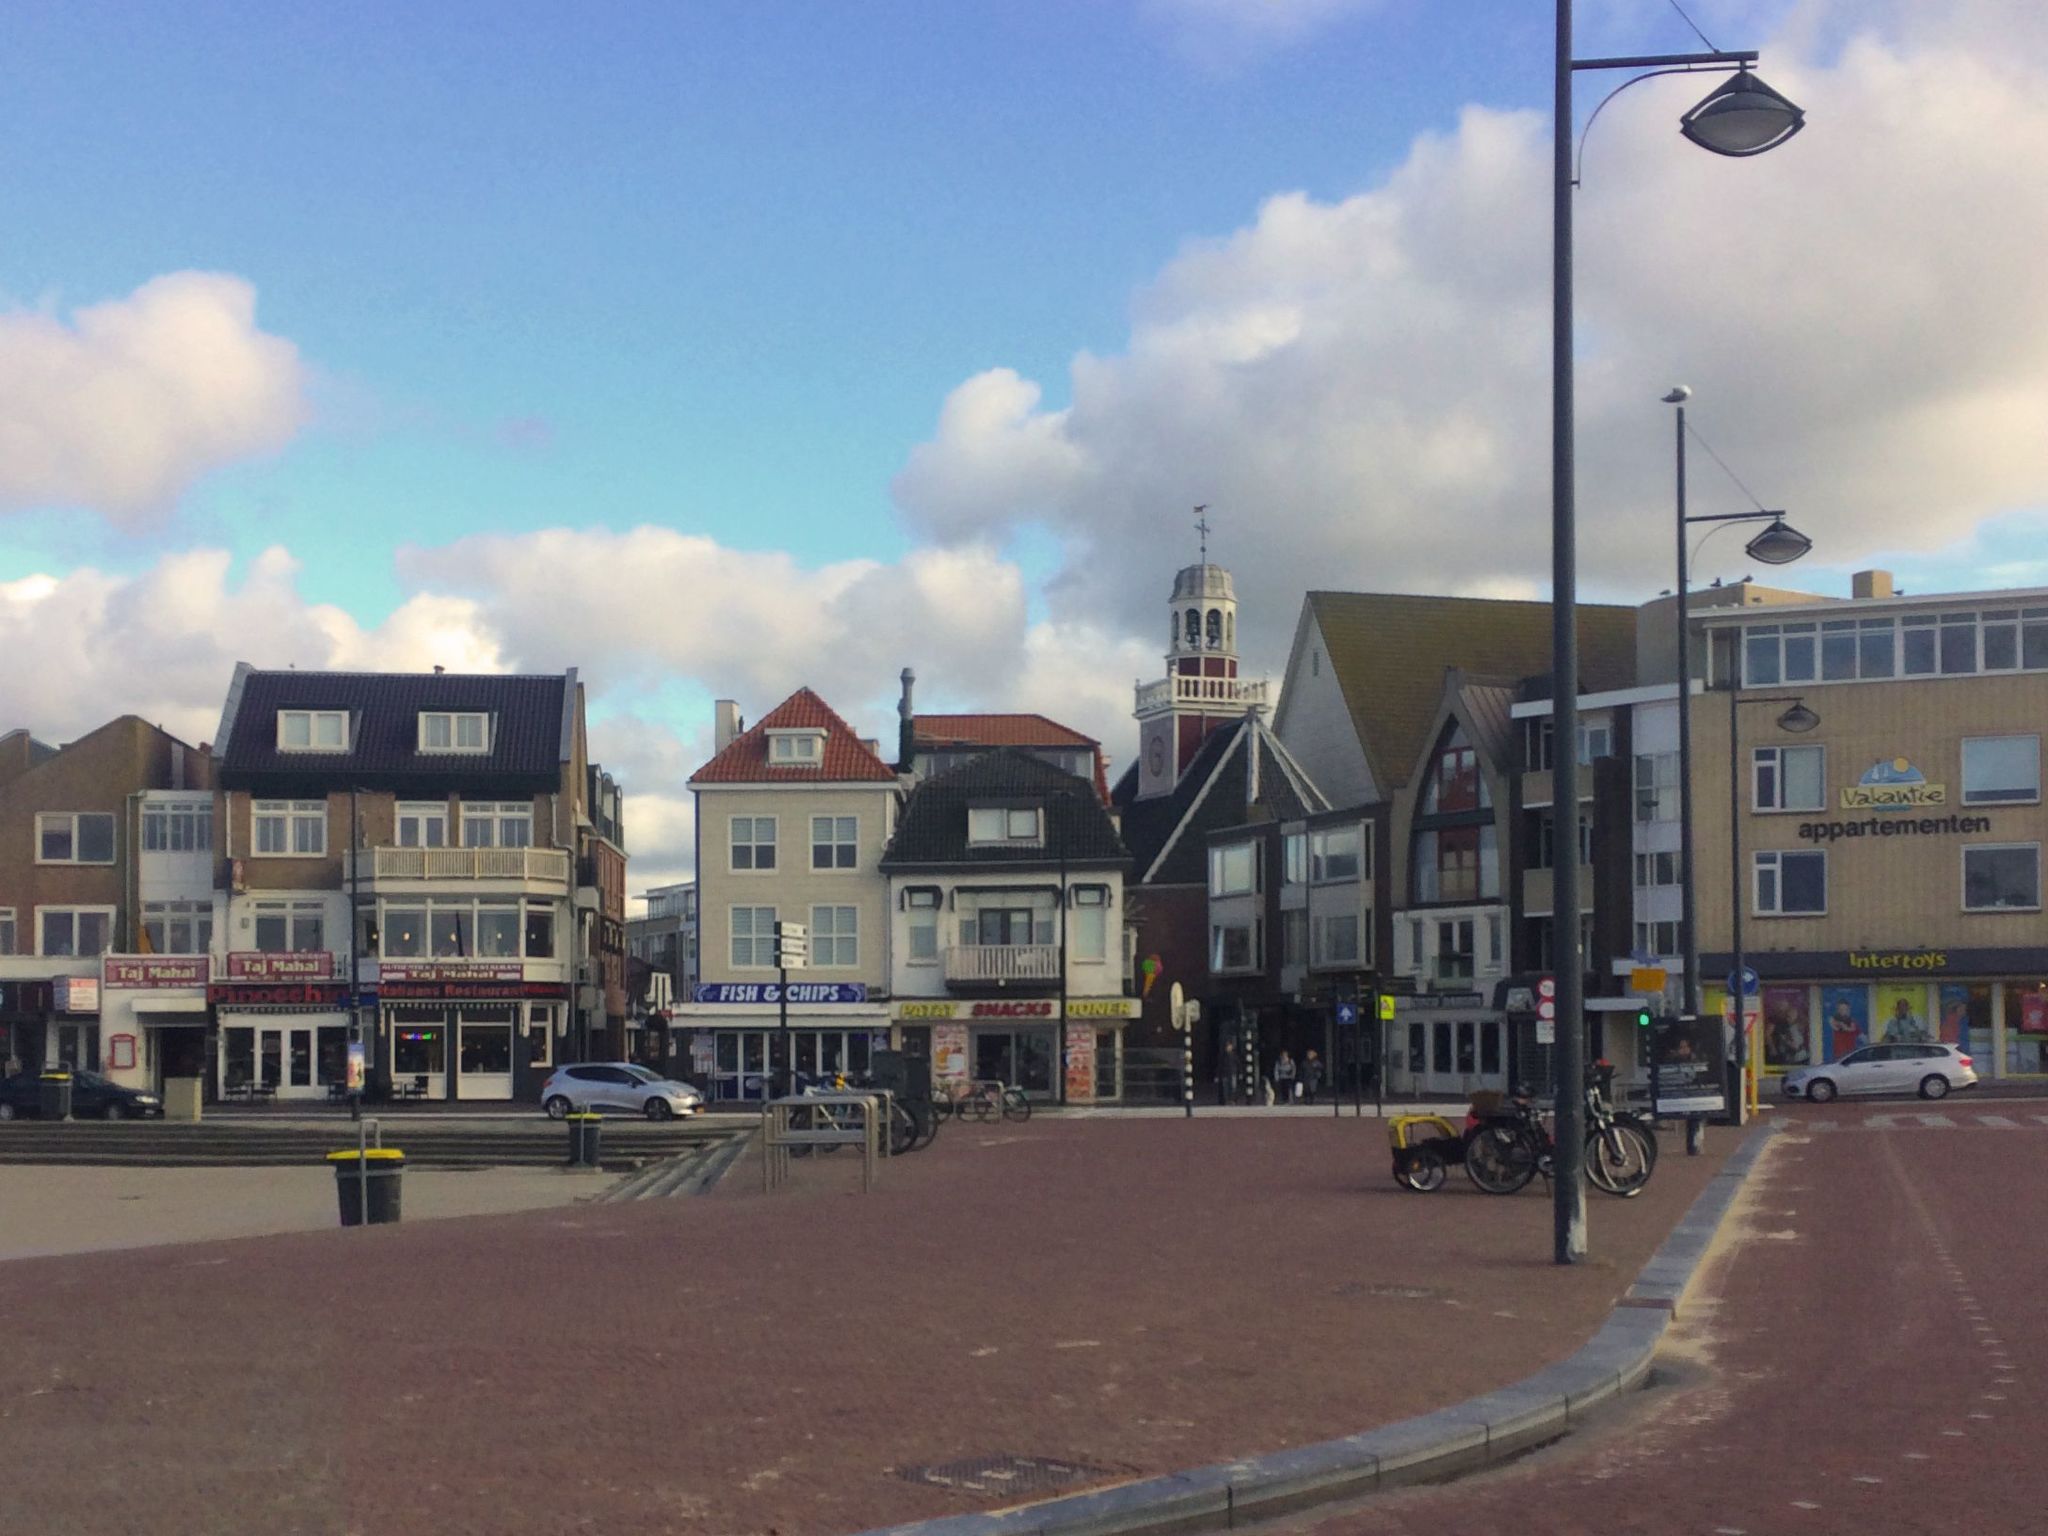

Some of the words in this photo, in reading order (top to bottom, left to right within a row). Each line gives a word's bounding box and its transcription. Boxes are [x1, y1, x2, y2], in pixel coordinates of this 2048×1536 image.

[1842, 784, 1944, 806] Vakantie
[1798, 814, 1991, 842] appartementen
[243, 960, 267, 974] Taj
[272, 960, 319, 972] Mahal
[1850, 952, 1947, 970] Intertoys
[118, 966, 144, 981] Taj
[148, 966, 196, 978] Mahal
[410, 970, 436, 979] Taj
[719, 984, 756, 1001] FISH
[763, 984, 781, 1001] &
[785, 984, 840, 1001] CHIPS
[970, 1002, 1052, 1017] SNACKS
